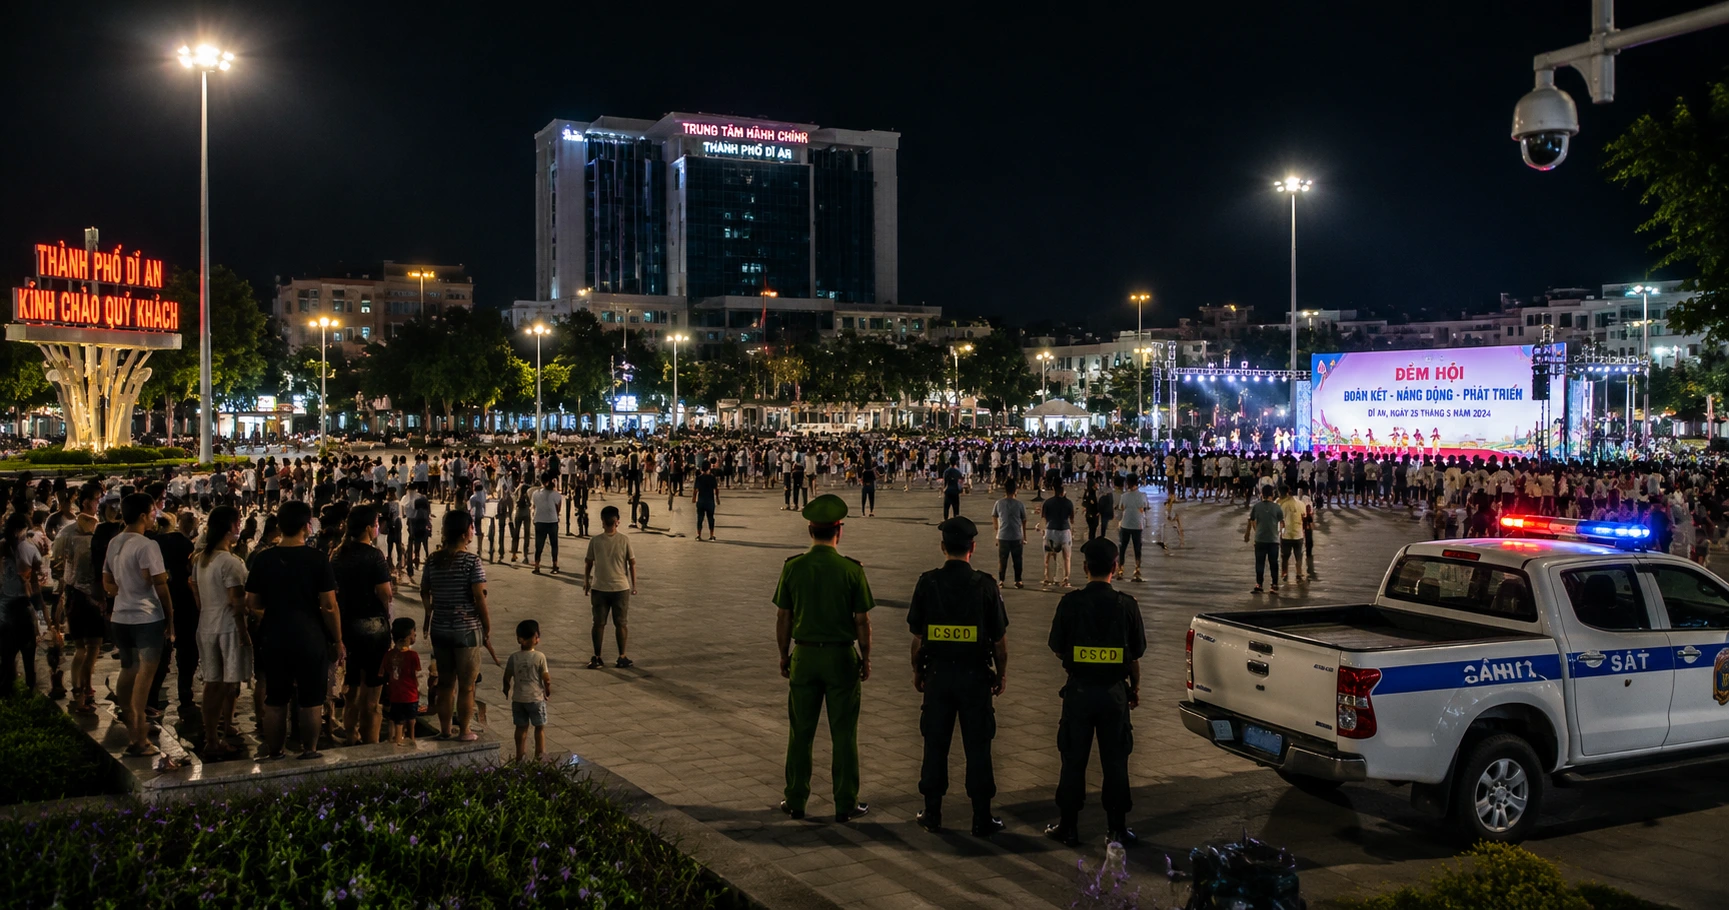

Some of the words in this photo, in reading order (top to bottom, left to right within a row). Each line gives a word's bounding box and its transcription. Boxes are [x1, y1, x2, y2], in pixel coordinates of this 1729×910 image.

[144, 259, 162, 288] AN
[1473, 409, 1491, 418] 2024
[934, 627, 971, 639] CSCD
[1080, 649, 1117, 661] CSCD
